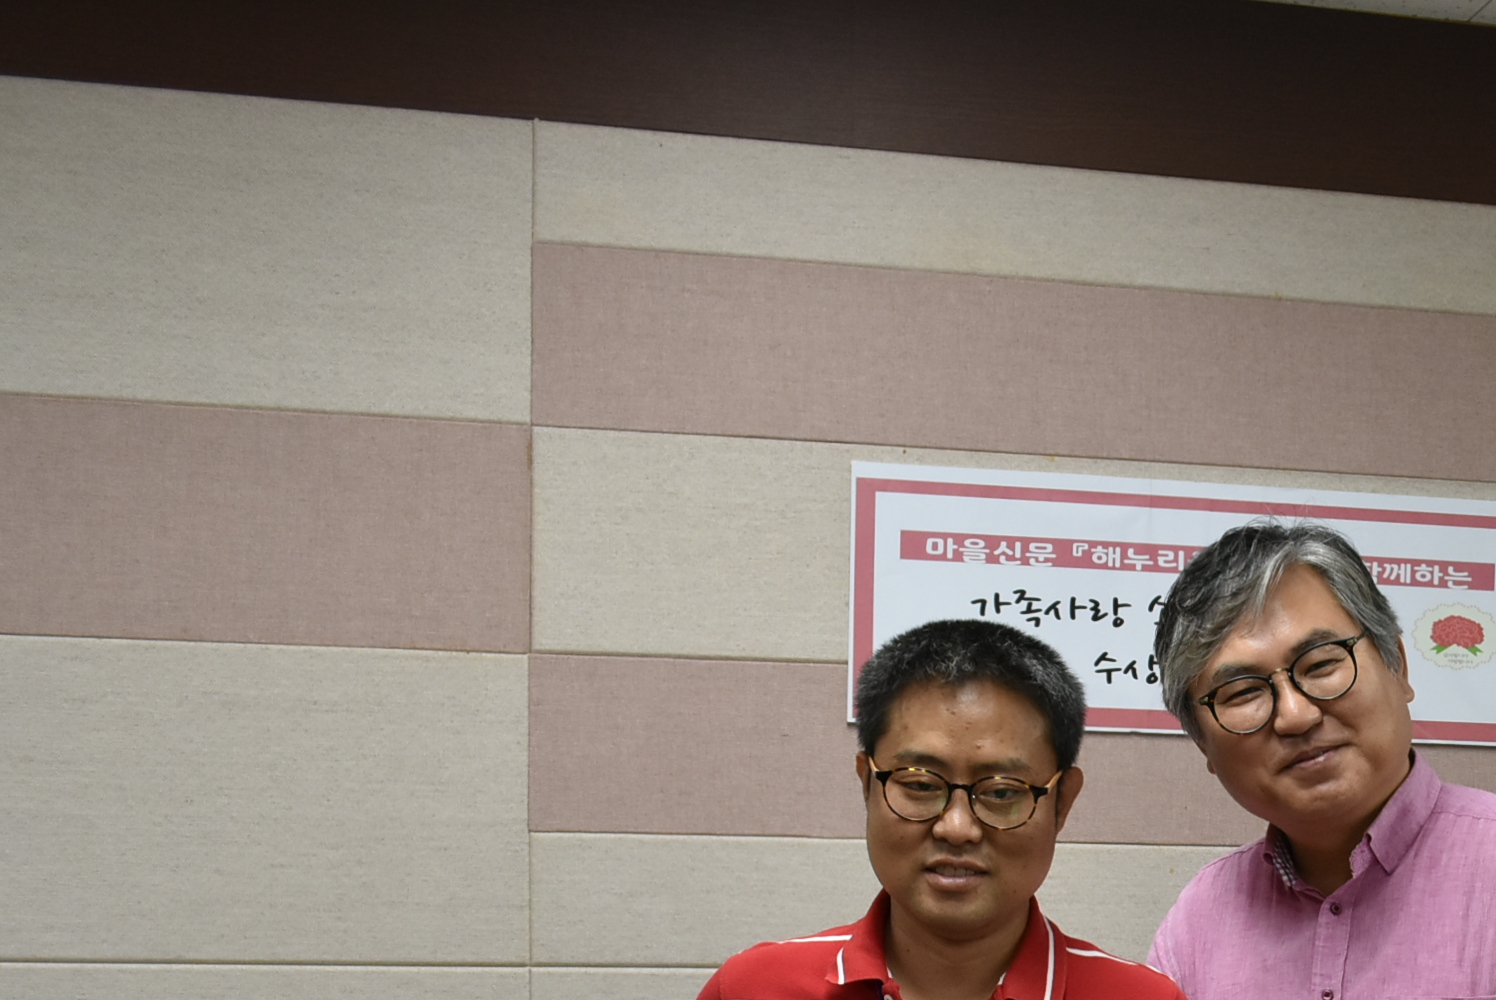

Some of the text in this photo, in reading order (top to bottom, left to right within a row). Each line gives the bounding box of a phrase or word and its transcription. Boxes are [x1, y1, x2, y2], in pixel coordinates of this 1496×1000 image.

[925, 536, 1057, 567] 마을신문
[1072, 542, 1192, 571] 『해누리
[970, 588, 1132, 628] 가족사랑
